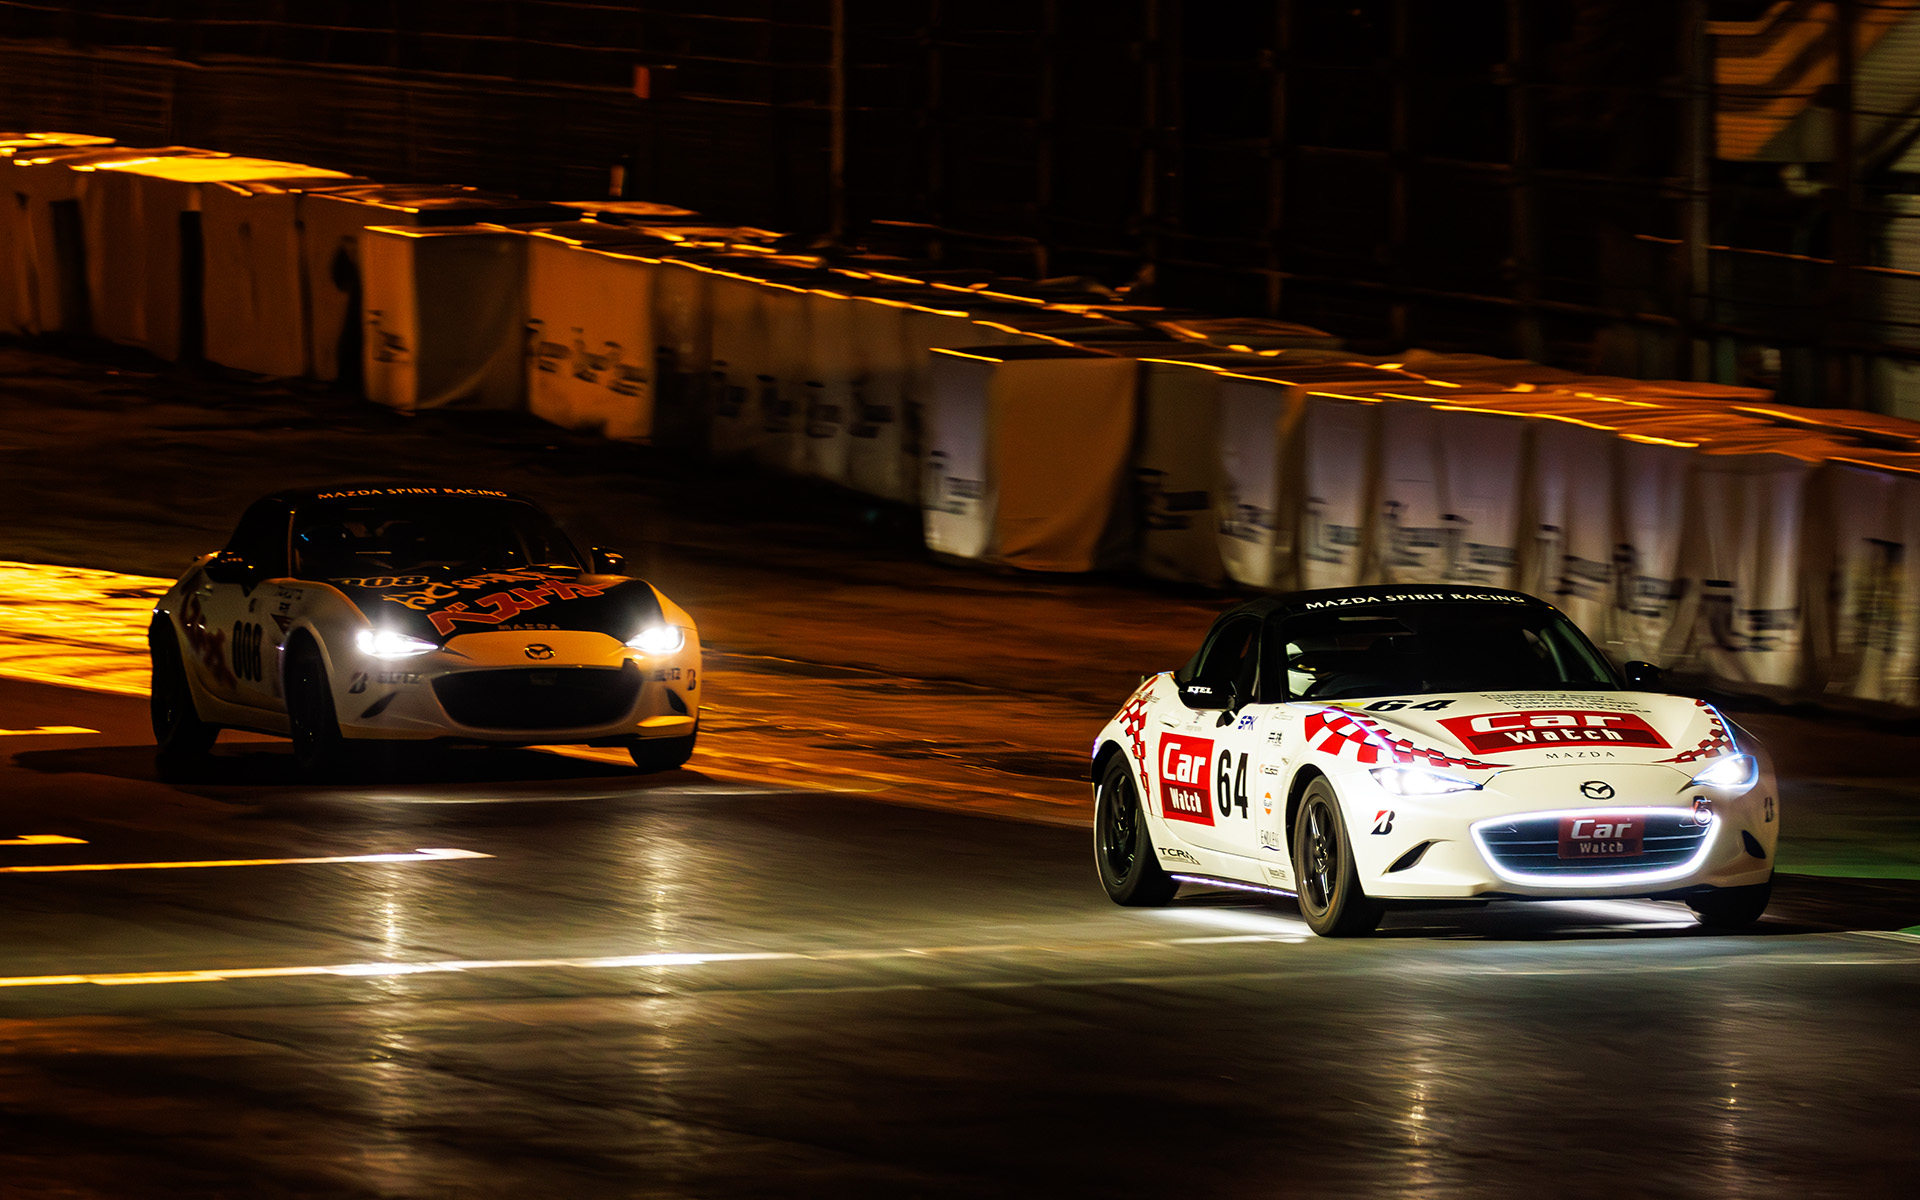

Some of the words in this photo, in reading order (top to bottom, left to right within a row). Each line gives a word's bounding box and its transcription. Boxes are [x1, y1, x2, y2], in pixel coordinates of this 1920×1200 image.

[317, 489, 383, 500] MAZDA
[387, 487, 438, 495] SPIRIT
[442, 488, 508, 498] RACING
[1305, 595, 1380, 610] MAZDA
[1385, 592, 1444, 603] SPIRIT
[1450, 592, 1526, 604] RACING
[498, 623, 560, 631] MAZDA
[233, 621, 262, 682] 008
[1364, 698, 1458, 712] 64
[1237, 715, 1258, 731] SPK
[1469, 712, 1623, 732] Car
[1503, 726, 1624, 744] Watch
[1162, 741, 1206, 785] Car
[1546, 751, 1616, 760] MAZDA
[1217, 749, 1249, 819] 64
[1169, 786, 1203, 813] Watch
[1570, 819, 1632, 840] Car
[1579, 840, 1624, 854] Watch
